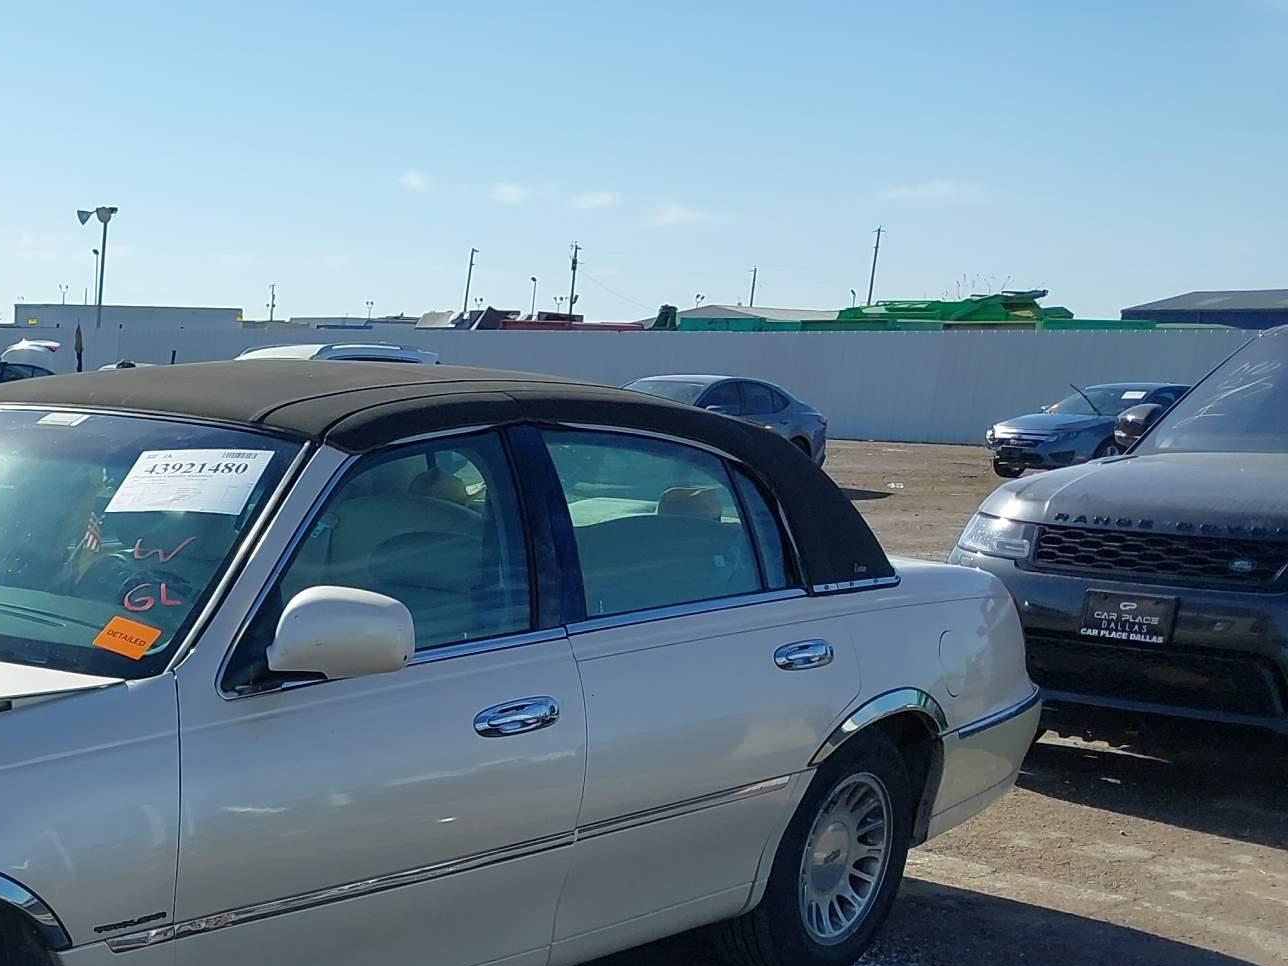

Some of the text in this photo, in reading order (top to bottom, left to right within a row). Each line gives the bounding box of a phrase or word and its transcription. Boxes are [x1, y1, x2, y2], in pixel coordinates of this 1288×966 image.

[144, 461, 249, 475] 43921480
[1054, 512, 1154, 529] RANGE
[1094, 611, 1160, 625] CAR PLACE
[1101, 620, 1148, 633] DALLAS
[106, 629, 146, 648] DETAILED
[1080, 628, 1164, 643] CAR PLACE DALLAS
